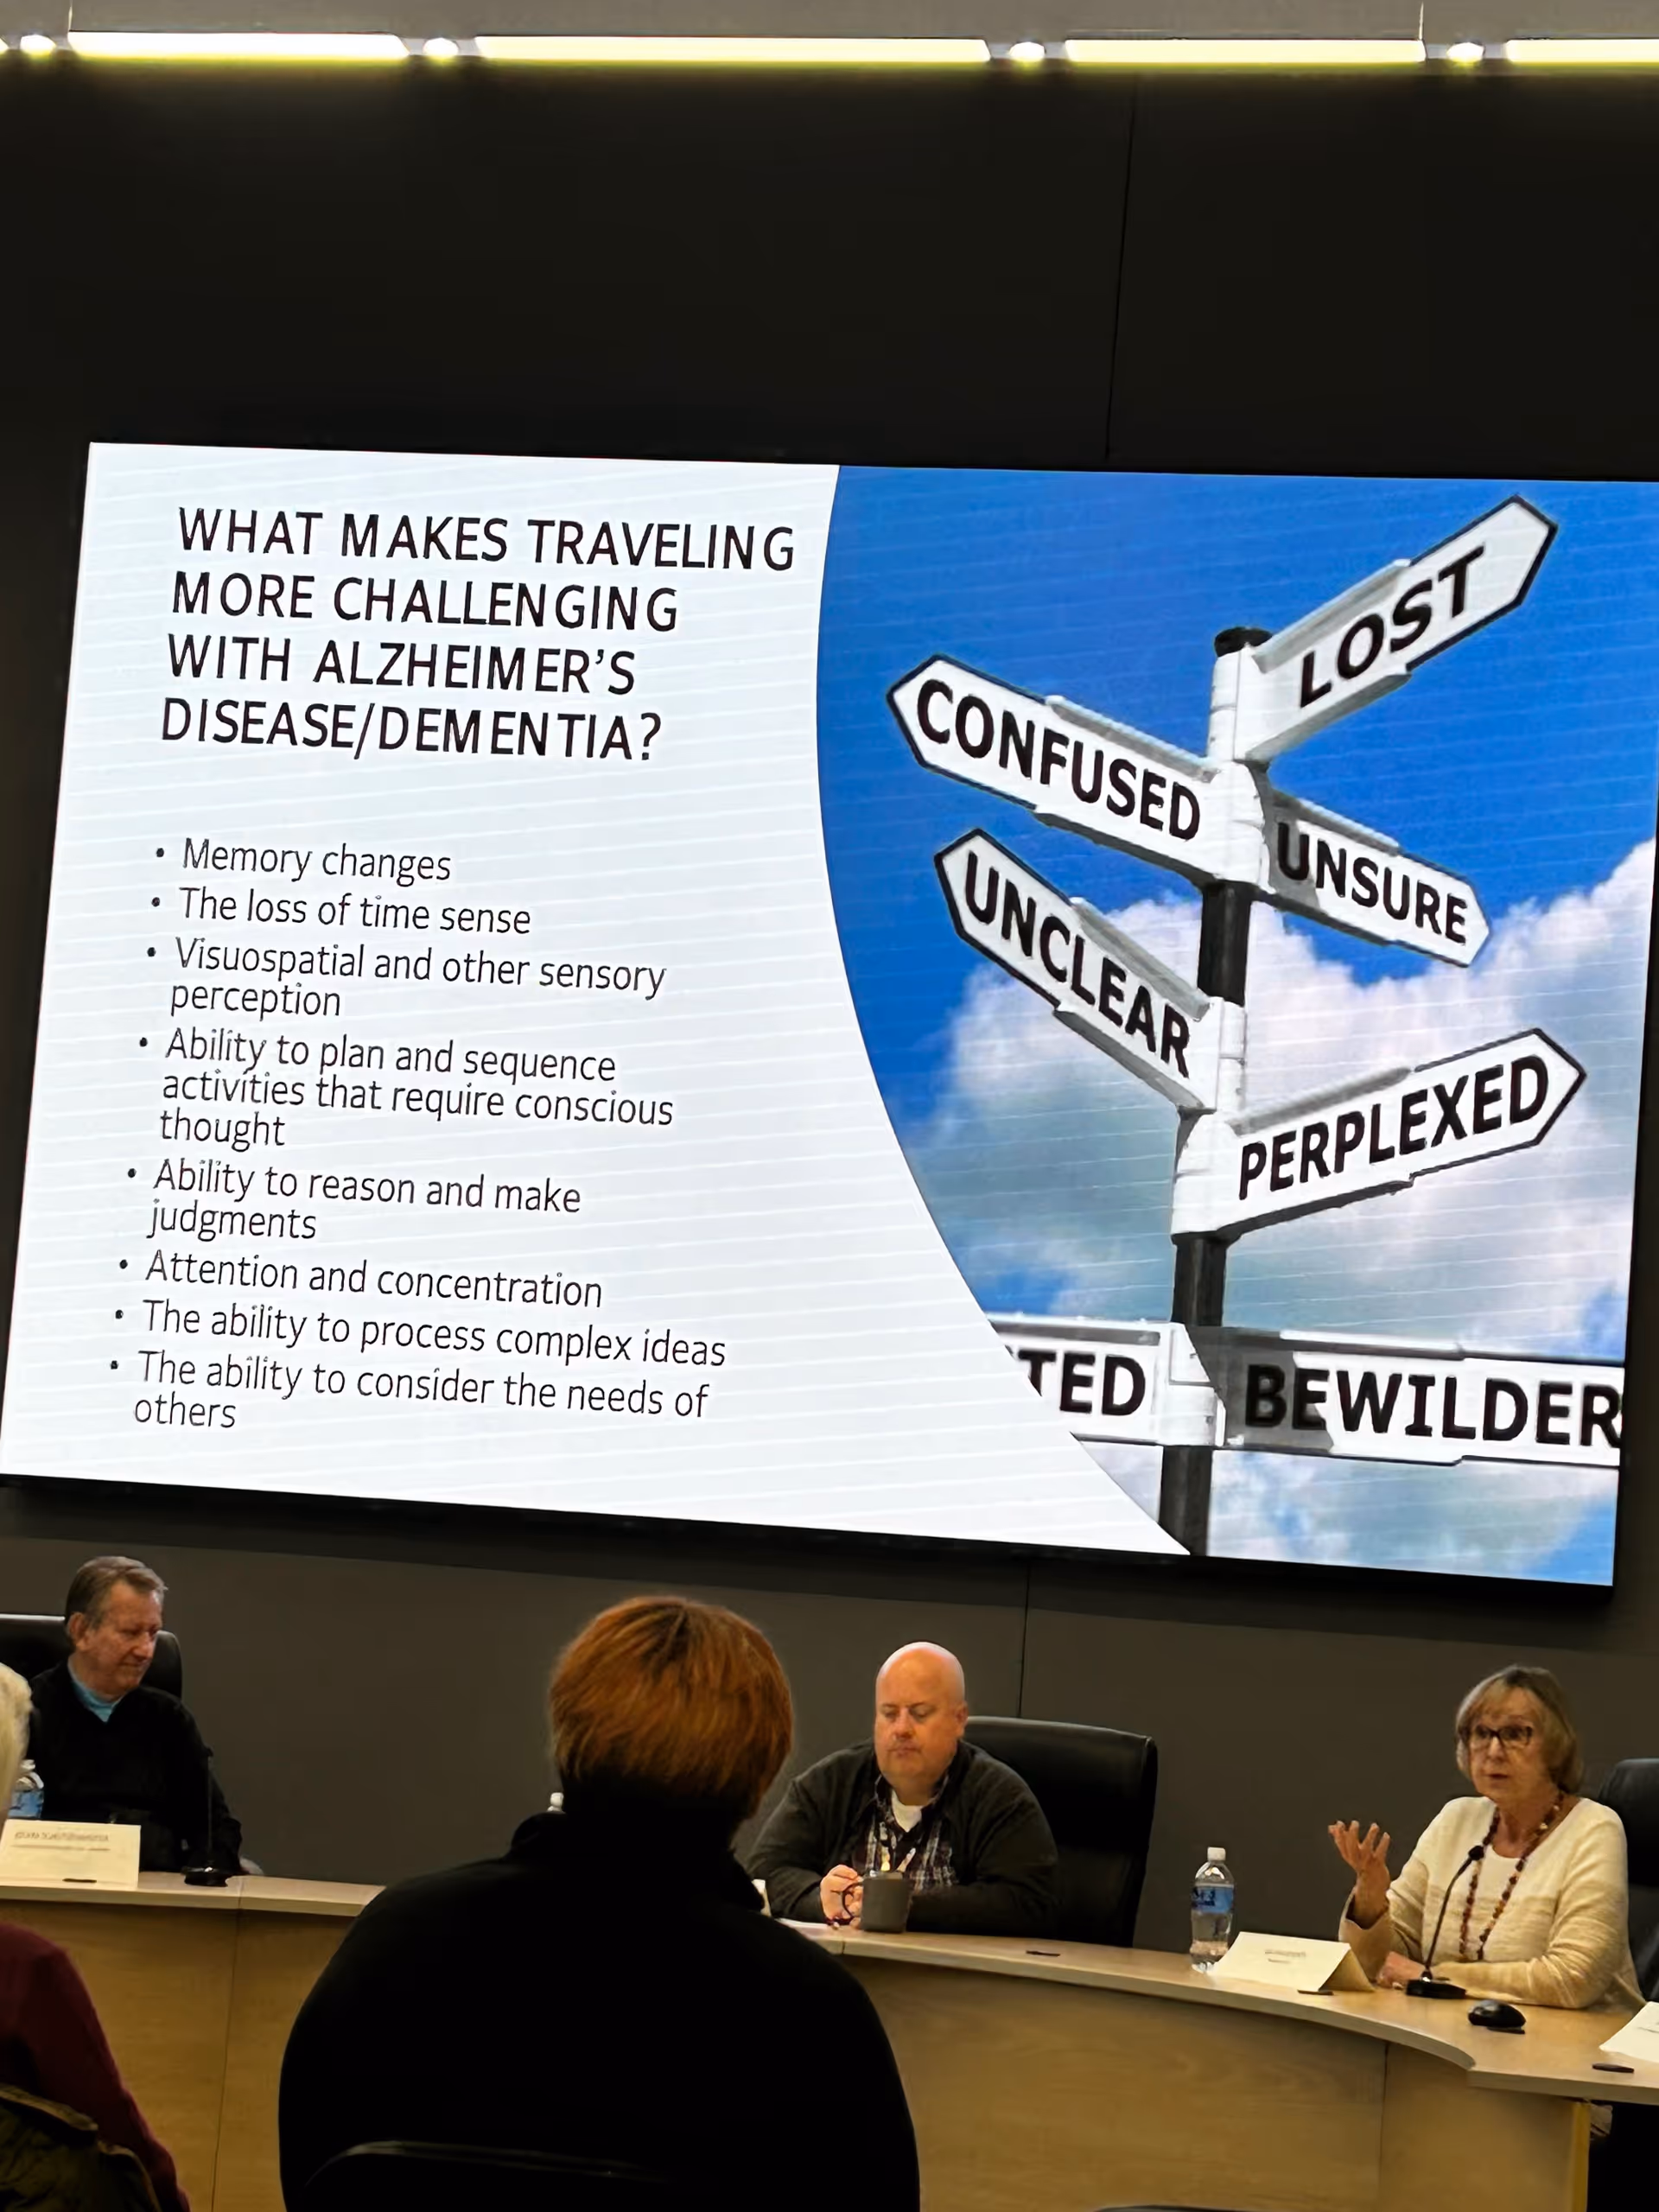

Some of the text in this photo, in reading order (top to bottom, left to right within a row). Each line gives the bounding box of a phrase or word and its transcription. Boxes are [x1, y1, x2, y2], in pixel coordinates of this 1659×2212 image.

[179, 507, 793, 571] WHAT MAKES TRAVELING
[173, 571, 677, 632] MORE CHALLENGING
[1300, 544, 1484, 709] LOST
[168, 633, 634, 695] WITH ALZHEIMER’S
[162, 697, 661, 760] DISEASE/DEMENTIA?
[916, 679, 1200, 841] CONFUSED
[182, 837, 450, 887] Memory changes
[1277, 822, 1467, 944] UNSURE
[179, 886, 531, 934] The loss of time sense
[175, 937, 666, 1001] Visuospatial and other sensory
[964, 851, 1191, 1078] UNCLEAR
[171, 982, 340, 1021] perception
[165, 1027, 615, 1085] Ability to plan and sequence
[162, 1069, 672, 1125] activities that require conscious
[1239, 1055, 1549, 1200] PERPLEXED
[160, 1107, 285, 1153] thought
[153, 1158, 580, 1212] Ability to reason and make
[146, 1199, 315, 1242] judgments
[145, 1249, 601, 1307] Attention and concentration
[143, 1299, 725, 1366] The ability to process complex ideas
[135, 1391, 236, 1428] others
[138, 1350, 709, 1417] The ability to consider the needs of
[1005, 1345, 1146, 1416] TED
[1244, 1363, 1622, 1448] BEWILDER
